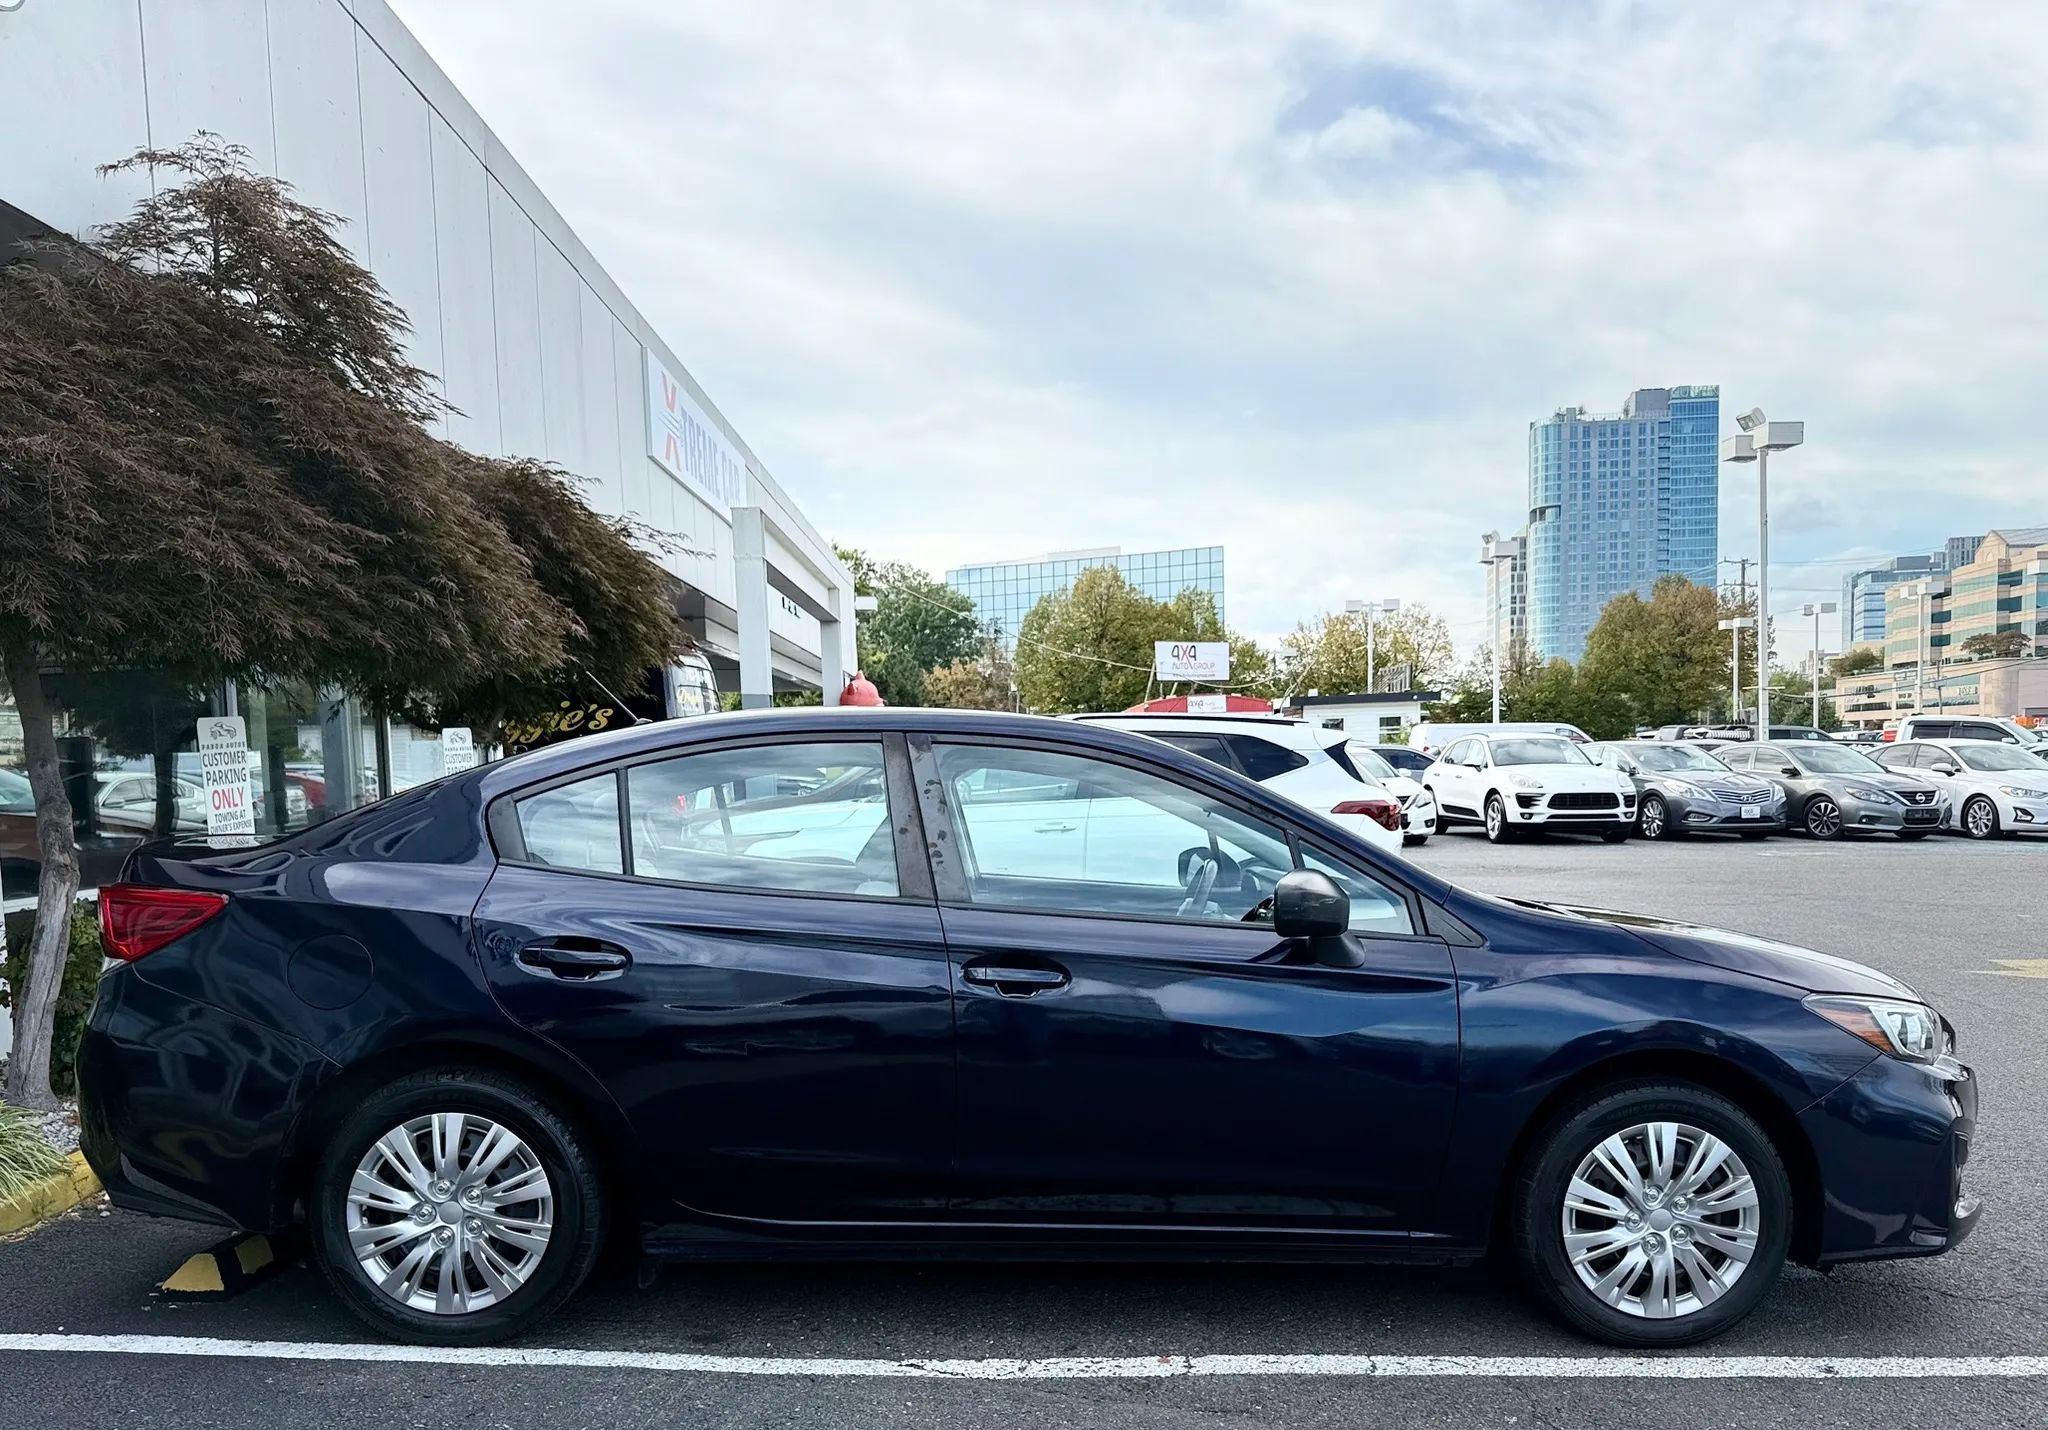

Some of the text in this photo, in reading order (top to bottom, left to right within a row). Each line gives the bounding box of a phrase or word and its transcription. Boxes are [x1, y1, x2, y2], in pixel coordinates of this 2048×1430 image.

[1171, 662, 1215, 671] AUTO GROUP
[202, 750, 247, 768] CUSTOMER
[445, 752, 472, 764] CUSTOMER
[206, 767, 247, 786] PARKING
[212, 786, 244, 811] ONLY
[214, 809, 246, 824] TOWING AT
[232, 819, 252, 831] EXPENSE
